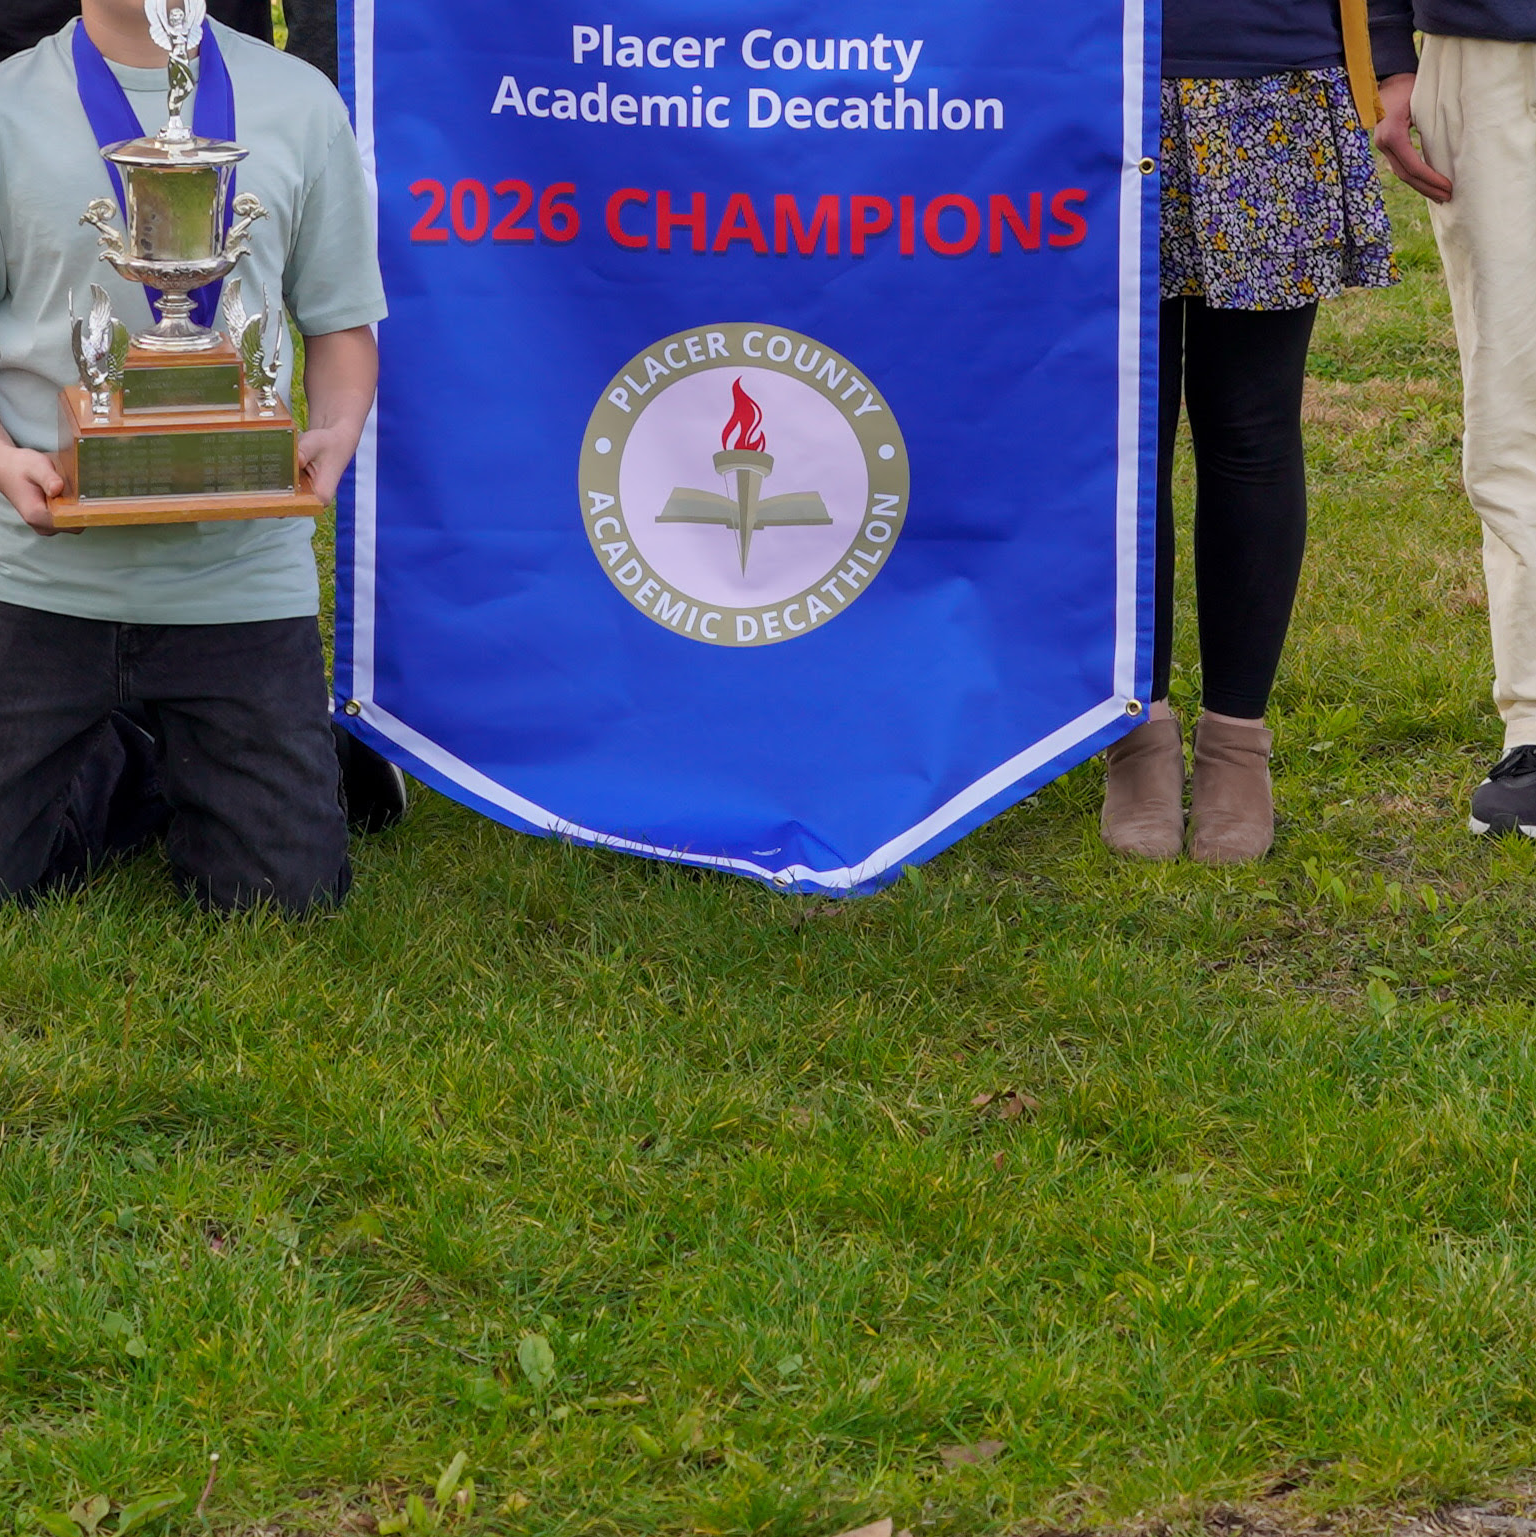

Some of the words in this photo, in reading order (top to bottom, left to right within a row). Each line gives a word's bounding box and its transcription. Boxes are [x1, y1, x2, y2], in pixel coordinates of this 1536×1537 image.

[572, 25, 726, 69] Placer
[740, 28, 923, 84] County
[491, 75, 730, 129] Academic
[747, 84, 1005, 131] Decathlon
[409, 178, 581, 244] 2026
[604, 187, 1089, 257] CHAMPIONS
[608, 332, 730, 413] PLACER
[742, 330, 882, 417] COUNTY
[587, 490, 722, 640] ACADEMIC
[735, 493, 900, 642] DECATHLON
